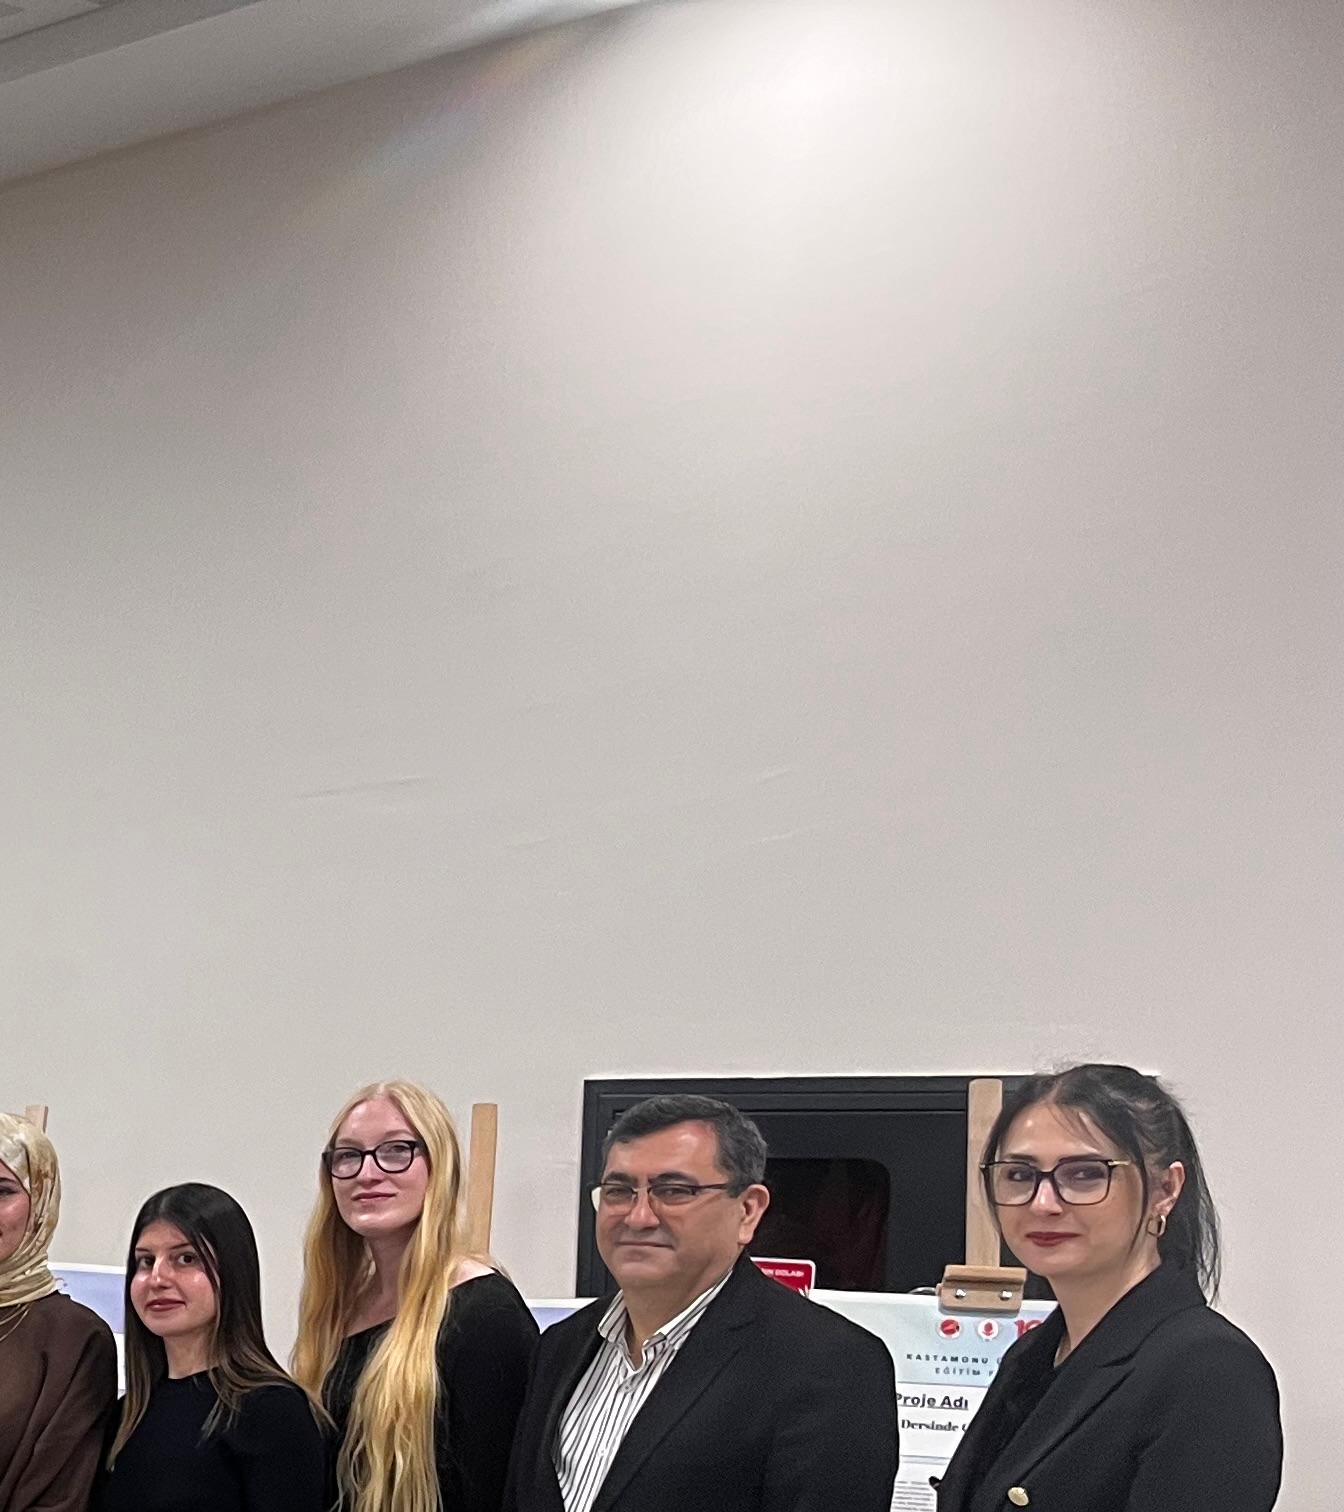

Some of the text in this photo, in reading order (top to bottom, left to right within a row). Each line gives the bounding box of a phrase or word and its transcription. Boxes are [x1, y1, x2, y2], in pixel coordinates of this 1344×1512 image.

[906, 1353, 989, 1365] KASTAMONU
[896, 1393, 969, 1409] Proje Adı
[901, 1419, 959, 1432] Dersinde
